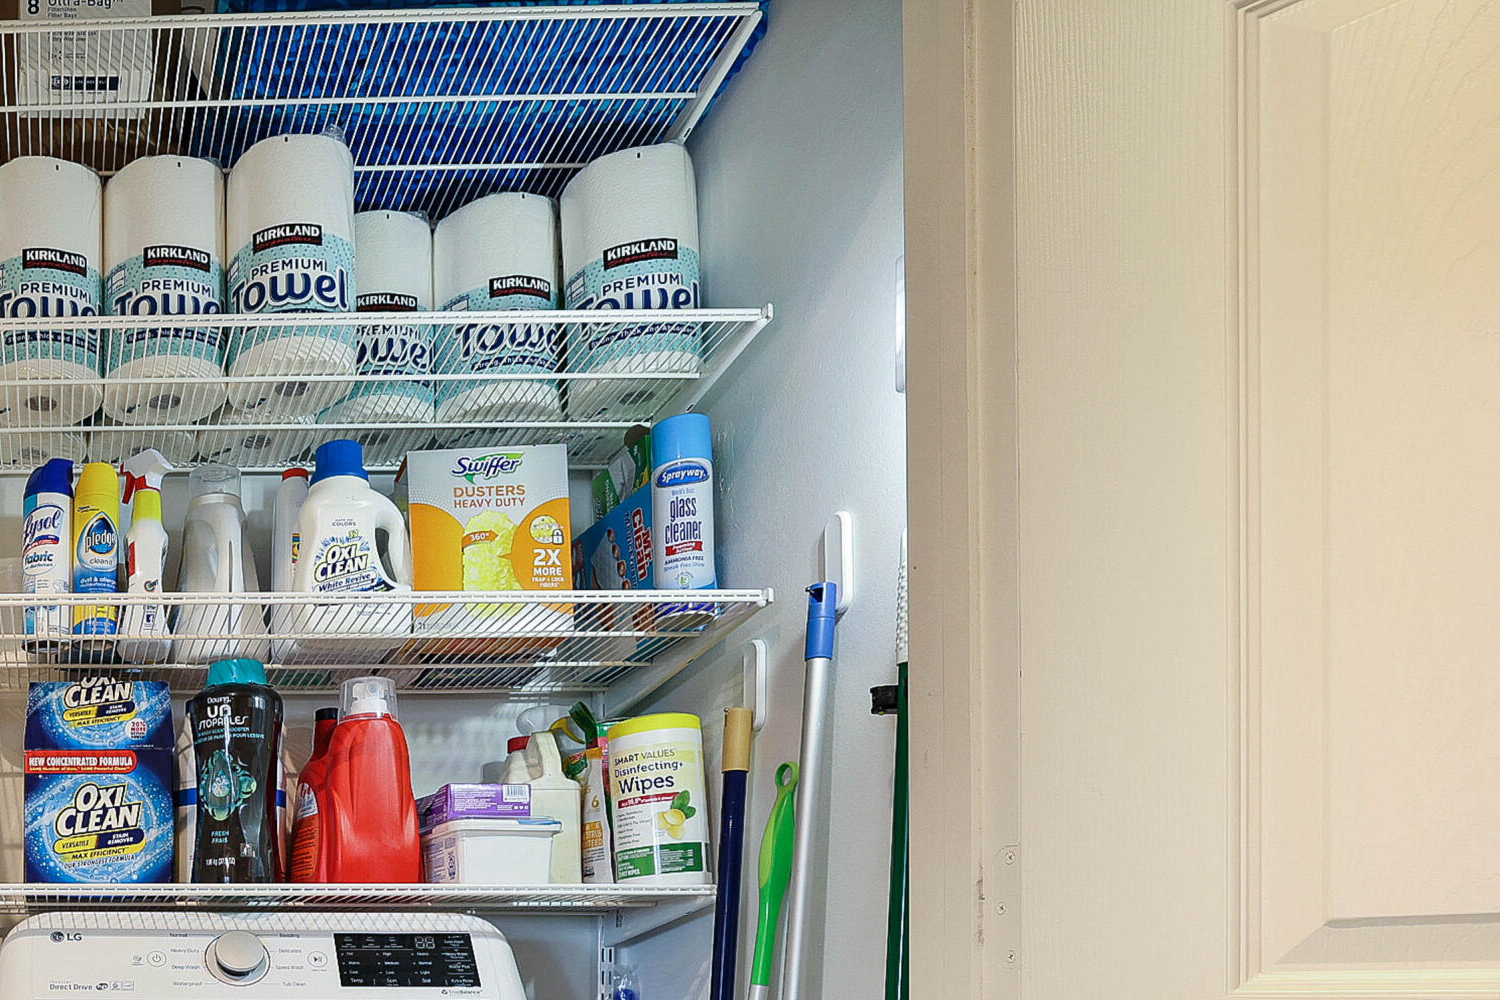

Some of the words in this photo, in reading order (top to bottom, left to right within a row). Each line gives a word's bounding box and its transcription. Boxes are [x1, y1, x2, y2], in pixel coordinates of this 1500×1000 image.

[256, 225, 320, 244] KIRKLAND
[26, 250, 86, 268] KIRKLAND
[147, 247, 210, 264] KIRKLAND
[607, 241, 675, 261] KIRKLAND
[251, 259, 324, 279] PREMIUM
[20, 283, 88, 301] PREMIUM
[142, 280, 211, 297] PREMIUM
[232, 269, 348, 314] Towel
[493, 277, 549, 292] KIRKLAND
[602, 273, 681, 296] PREMIUM
[357, 295, 416, 308] KIRKLAND
[452, 455, 519, 477] Swiffer
[662, 467, 704, 482] Sprayway
[453, 485, 525, 498] DUSTERS
[454, 499, 491, 509] HEAVY
[495, 497, 525, 507] DUTY
[670, 496, 697, 522] glass
[23, 510, 61, 543] Lysol
[665, 521, 702, 544] cleaner
[85, 530, 116, 553] pledge
[632, 508, 647, 581] Clean
[25, 551, 53, 566] fabric
[327, 545, 357, 564] OXI
[533, 549, 561, 566] 2X
[665, 556, 691, 566] AMMONIA
[315, 555, 368, 582] CLEAN
[533, 567, 562, 576] MORE
[319, 579, 343, 592] White
[345, 573, 371, 584] Revive
[65, 682, 132, 708] CLEAN
[69, 710, 91, 718] VERSATILE
[29, 757, 45, 766] NEW
[47, 757, 98, 766] CONCENTRATED
[99, 757, 133, 766] FORMULA
[614, 753, 639, 765] SMART
[641, 748, 675, 760] VALUES
[618, 774, 675, 794] Wipes
[76, 783, 125, 811] OXI
[56, 804, 140, 837] CLEAN
[62, 840, 90, 849] VERSATILE
[107, 837, 134, 845] REMOVER
[77, 859, 108, 867] STRONGEST
[109, 854, 135, 863] FORMULA
[67, 933, 83, 941] LG
